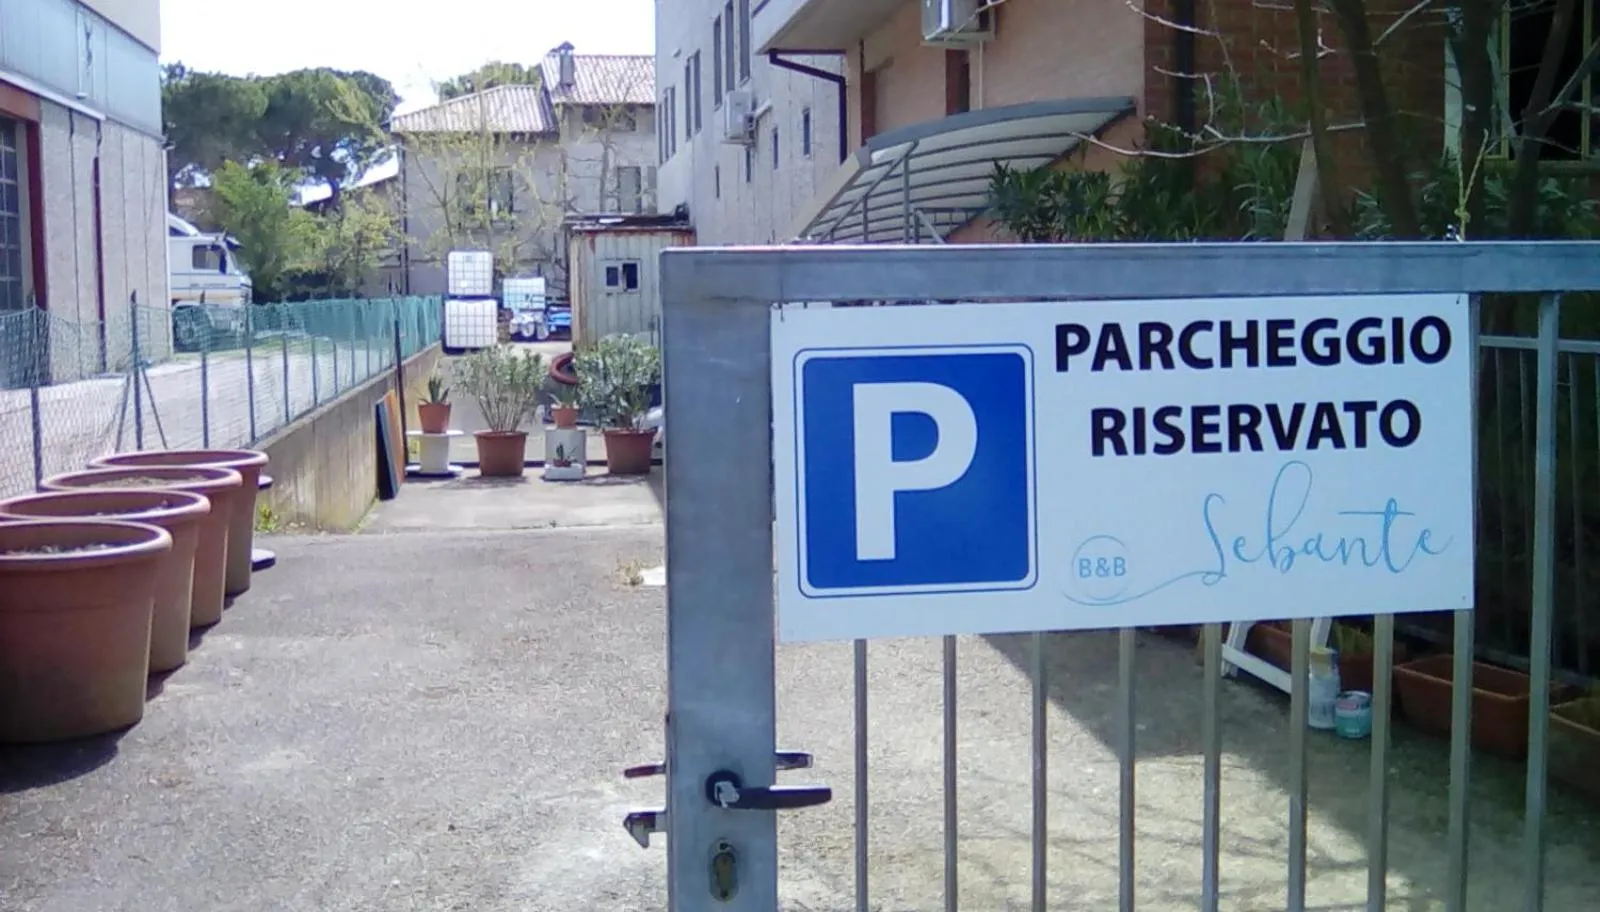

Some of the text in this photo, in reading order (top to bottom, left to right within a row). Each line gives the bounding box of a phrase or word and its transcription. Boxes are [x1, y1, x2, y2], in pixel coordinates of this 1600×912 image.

[1054, 316, 1452, 373] PARCHEGGIO
[1090, 399, 1422, 457] RISERVATO
[852, 381, 978, 561] P
[1200, 460, 1454, 586] Sebante
[1078, 556, 1127, 579] B&B
